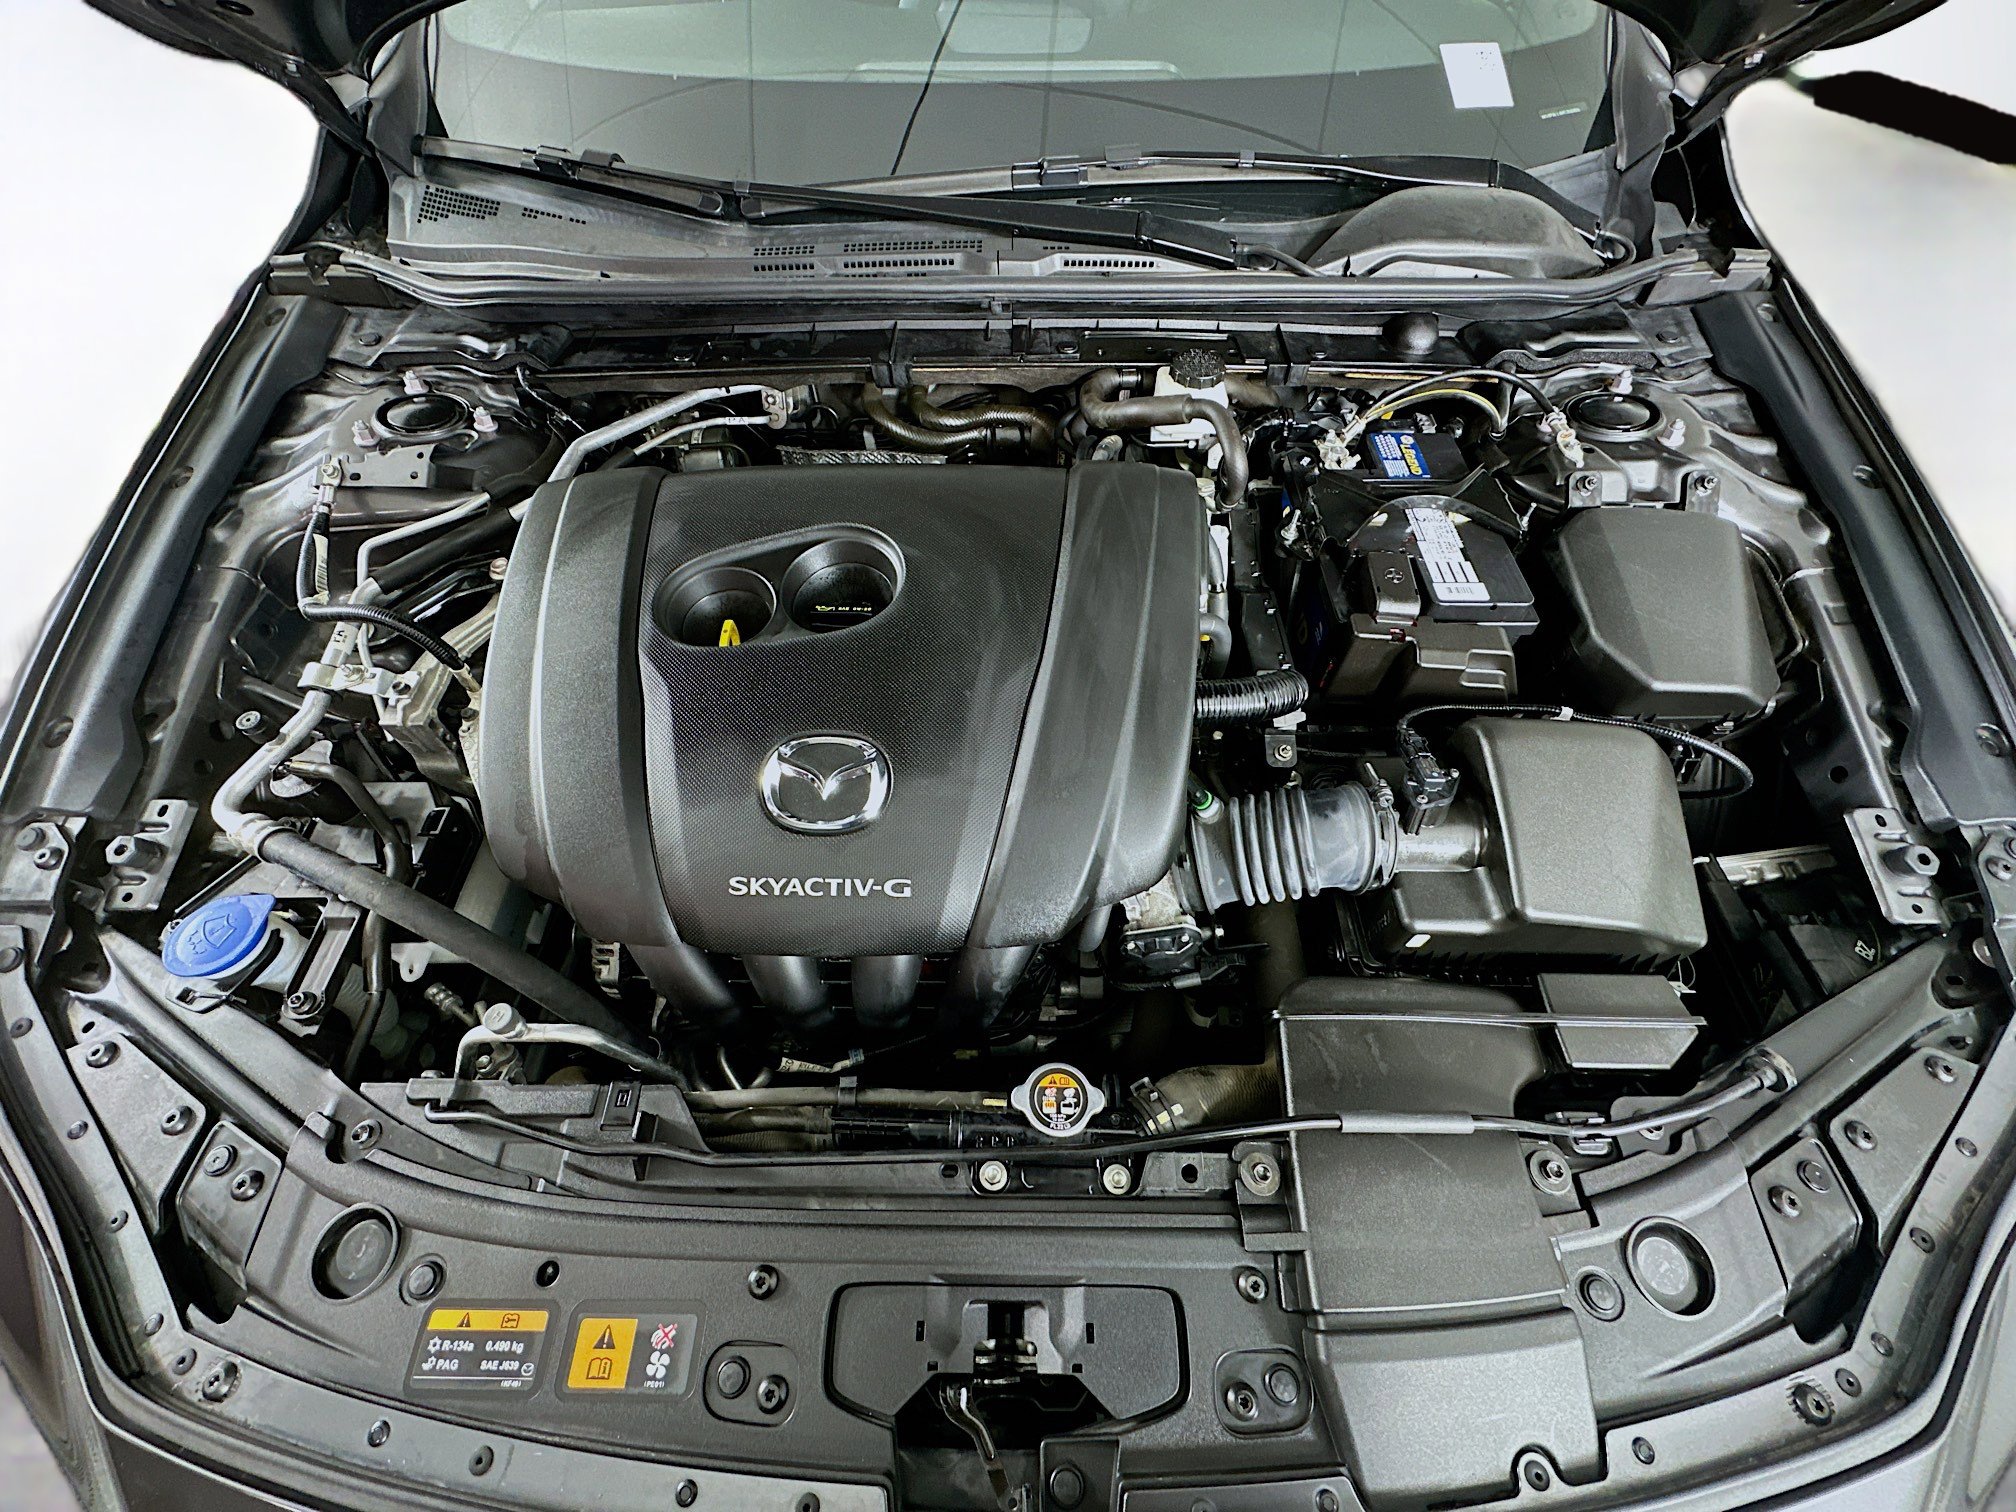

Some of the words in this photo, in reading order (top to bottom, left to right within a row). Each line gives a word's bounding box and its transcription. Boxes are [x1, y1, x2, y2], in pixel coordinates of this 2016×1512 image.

[728, 876, 912, 898] SKYACTIV-G
[442, 1340, 475, 1352] R-134a
[485, 1340, 510, 1352] 0.490
[511, 1340, 524, 1354] kg
[435, 1359, 459, 1371] PAG
[480, 1360, 499, 1371] SAE
